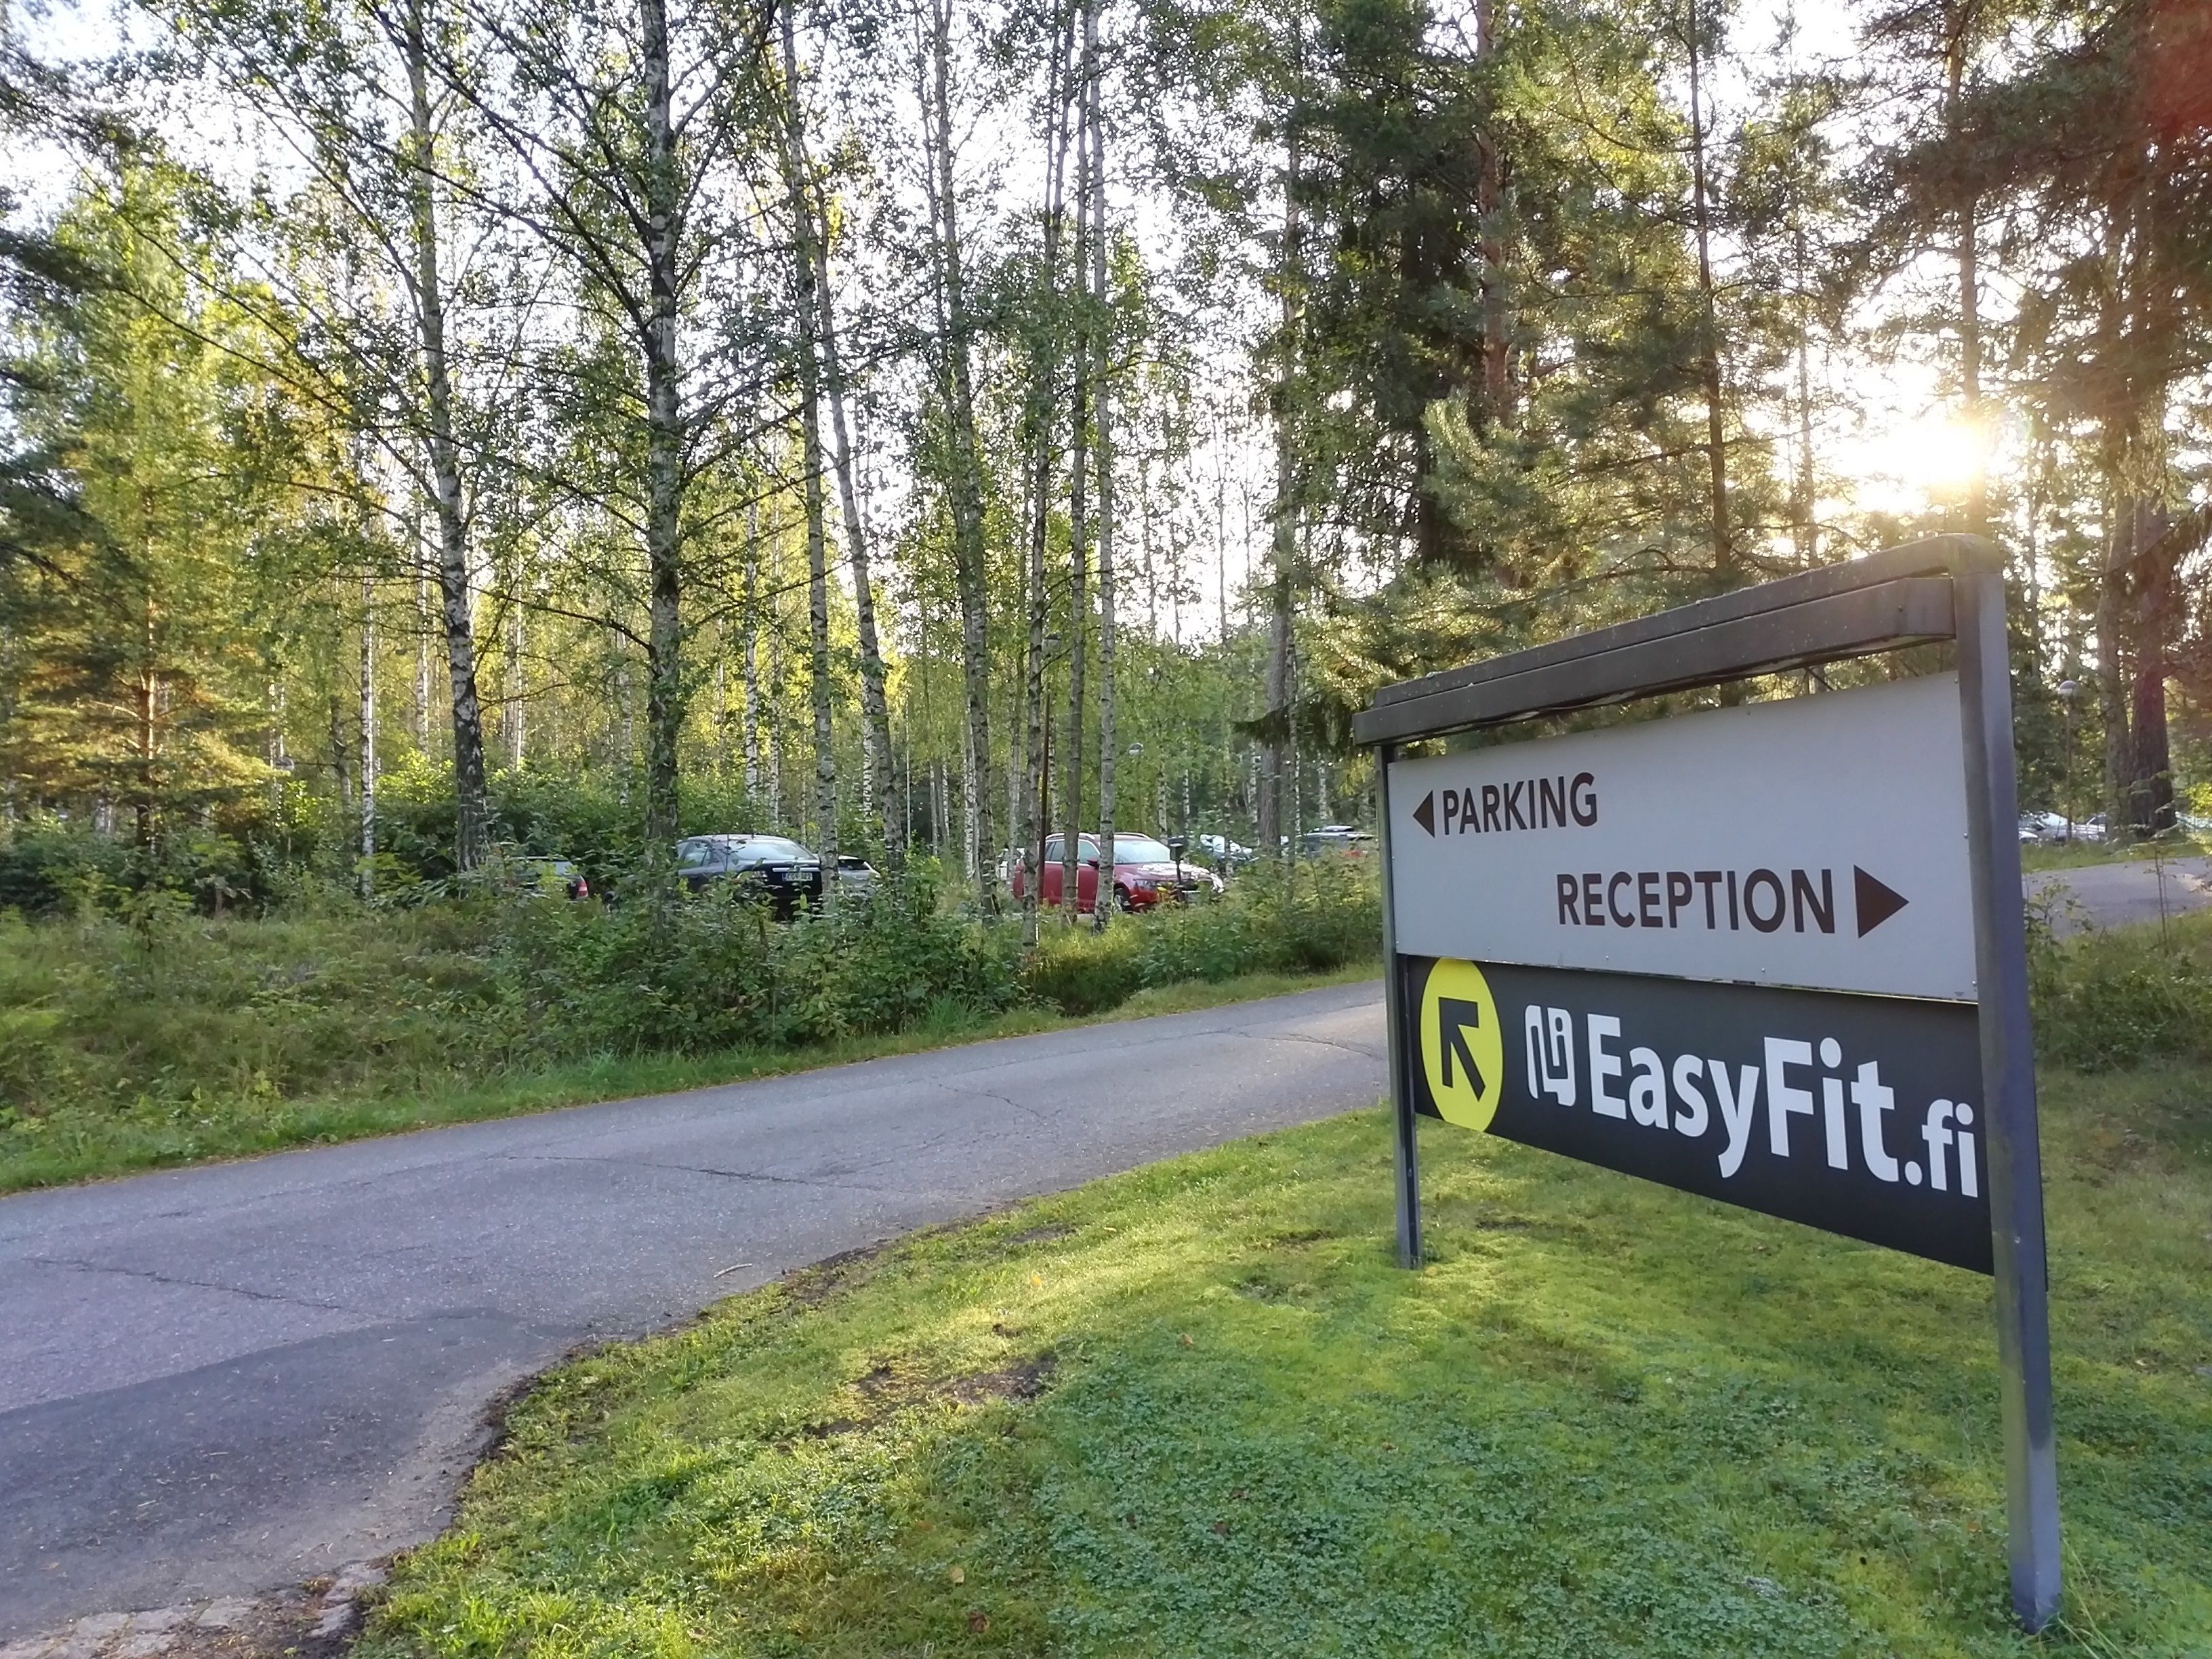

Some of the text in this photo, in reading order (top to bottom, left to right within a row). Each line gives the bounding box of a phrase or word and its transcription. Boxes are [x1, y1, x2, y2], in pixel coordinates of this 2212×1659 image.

[1443, 772, 1598, 835] PARKING
[1557, 868, 1835, 934] RECEPTION
[1587, 1013, 1978, 1198] EasyFit.fi
